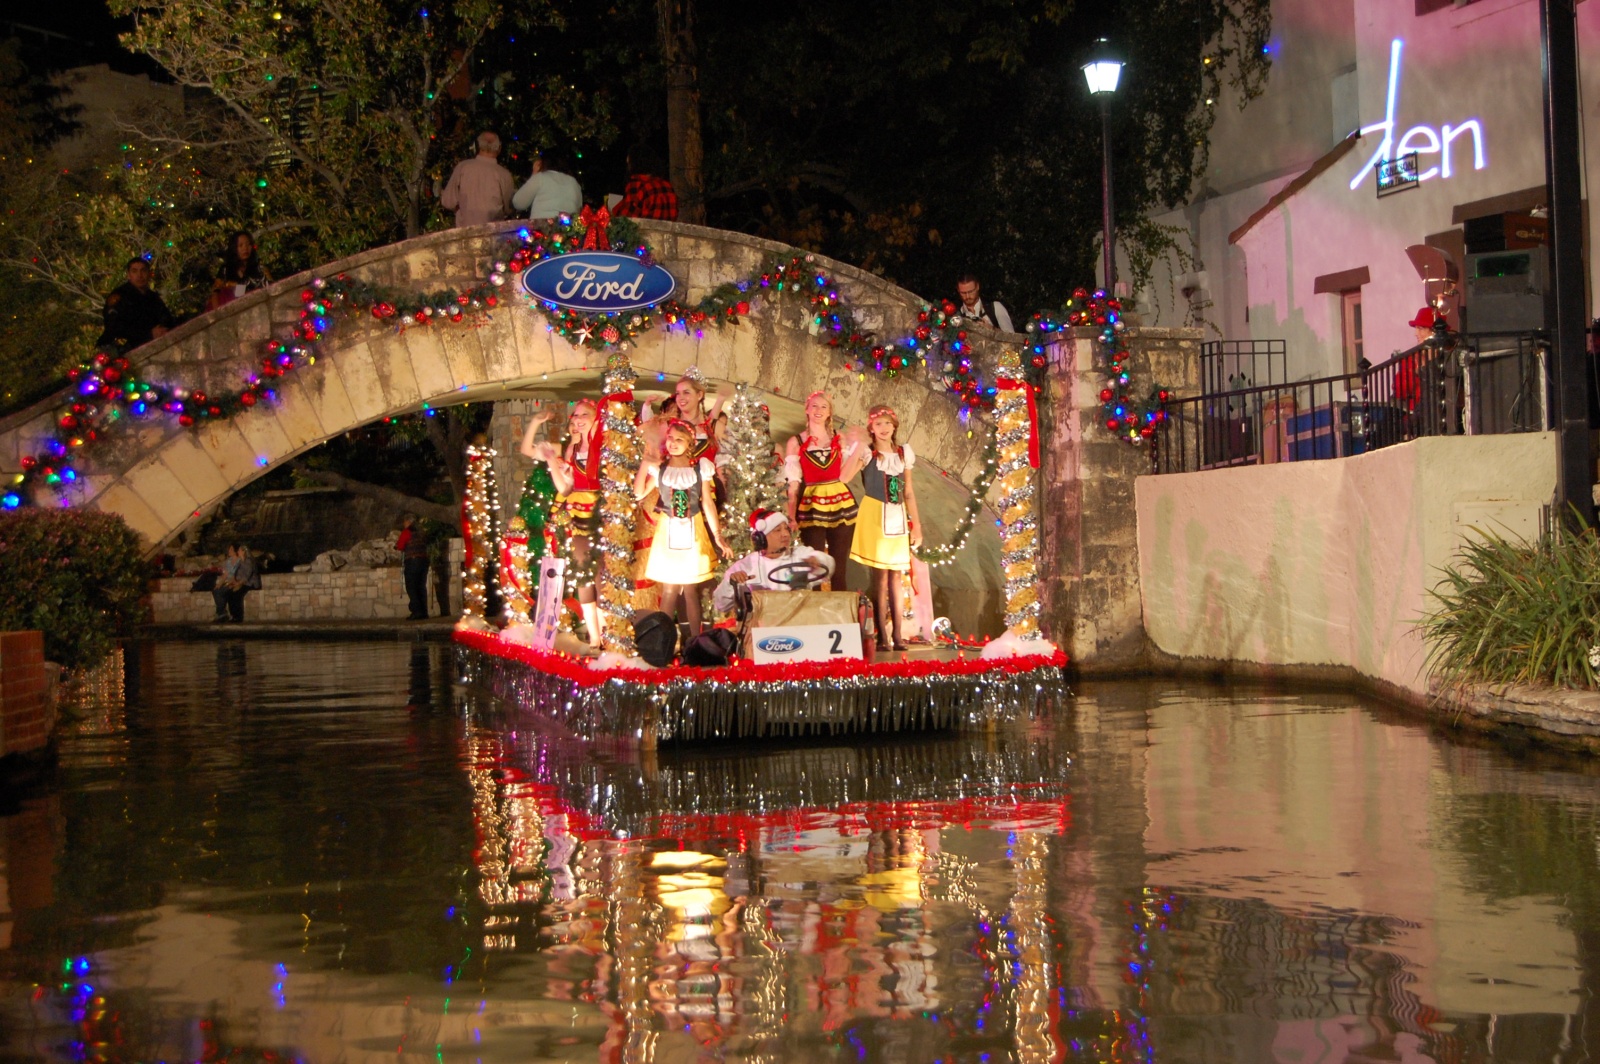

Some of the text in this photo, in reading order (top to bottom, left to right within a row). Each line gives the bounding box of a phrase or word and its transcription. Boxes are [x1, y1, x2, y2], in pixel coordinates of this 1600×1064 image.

[555, 261, 645, 301] Ford
[765, 630, 843, 655] Ford 2
